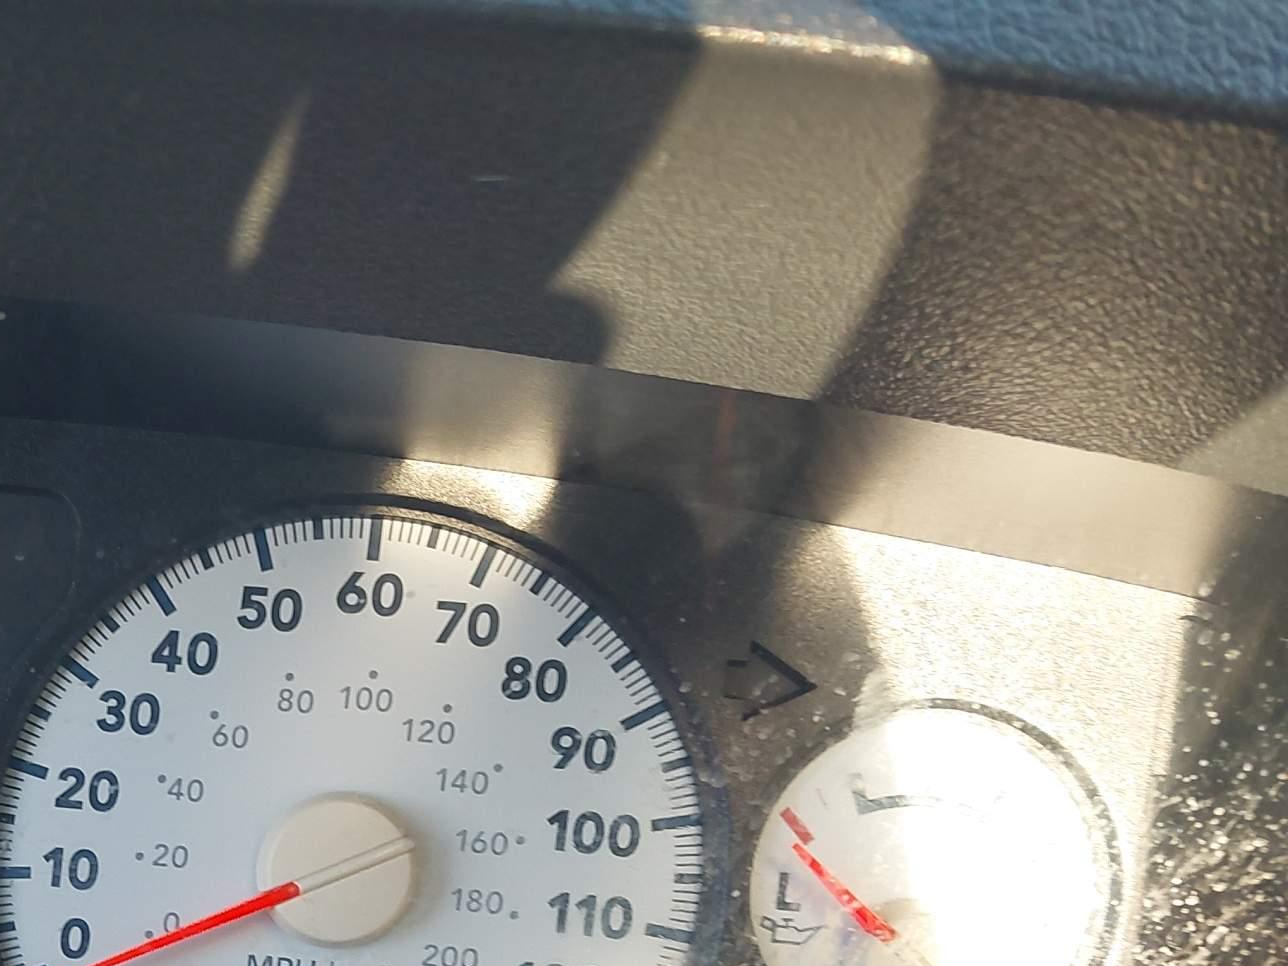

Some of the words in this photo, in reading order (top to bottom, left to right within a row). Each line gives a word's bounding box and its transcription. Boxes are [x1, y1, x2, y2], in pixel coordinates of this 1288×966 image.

[237, 587, 302, 632] 50
[336, 572, 403, 616] 60
[436, 601, 499, 647] 70
[151, 631, 218, 675] 40
[340, 687, 393, 712] 100
[500, 657, 567, 702] 80
[96, 690, 159, 735] 30
[277, 689, 313, 714] 80
[212, 724, 248, 749] 60
[403, 720, 455, 745] 120
[551, 727, 616, 771] 90
[55, 767, 120, 812] 20
[167, 778, 203, 802] 40
[436, 769, 488, 795] 140
[457, 829, 507, 855] 160
[547, 810, 639, 857] 100
[43, 848, 99, 889] 10
[152, 845, 188, 868] 20
[451, 889, 503, 914] 180
[547, 892, 633, 939] 110
[60, 917, 91, 960] 0
